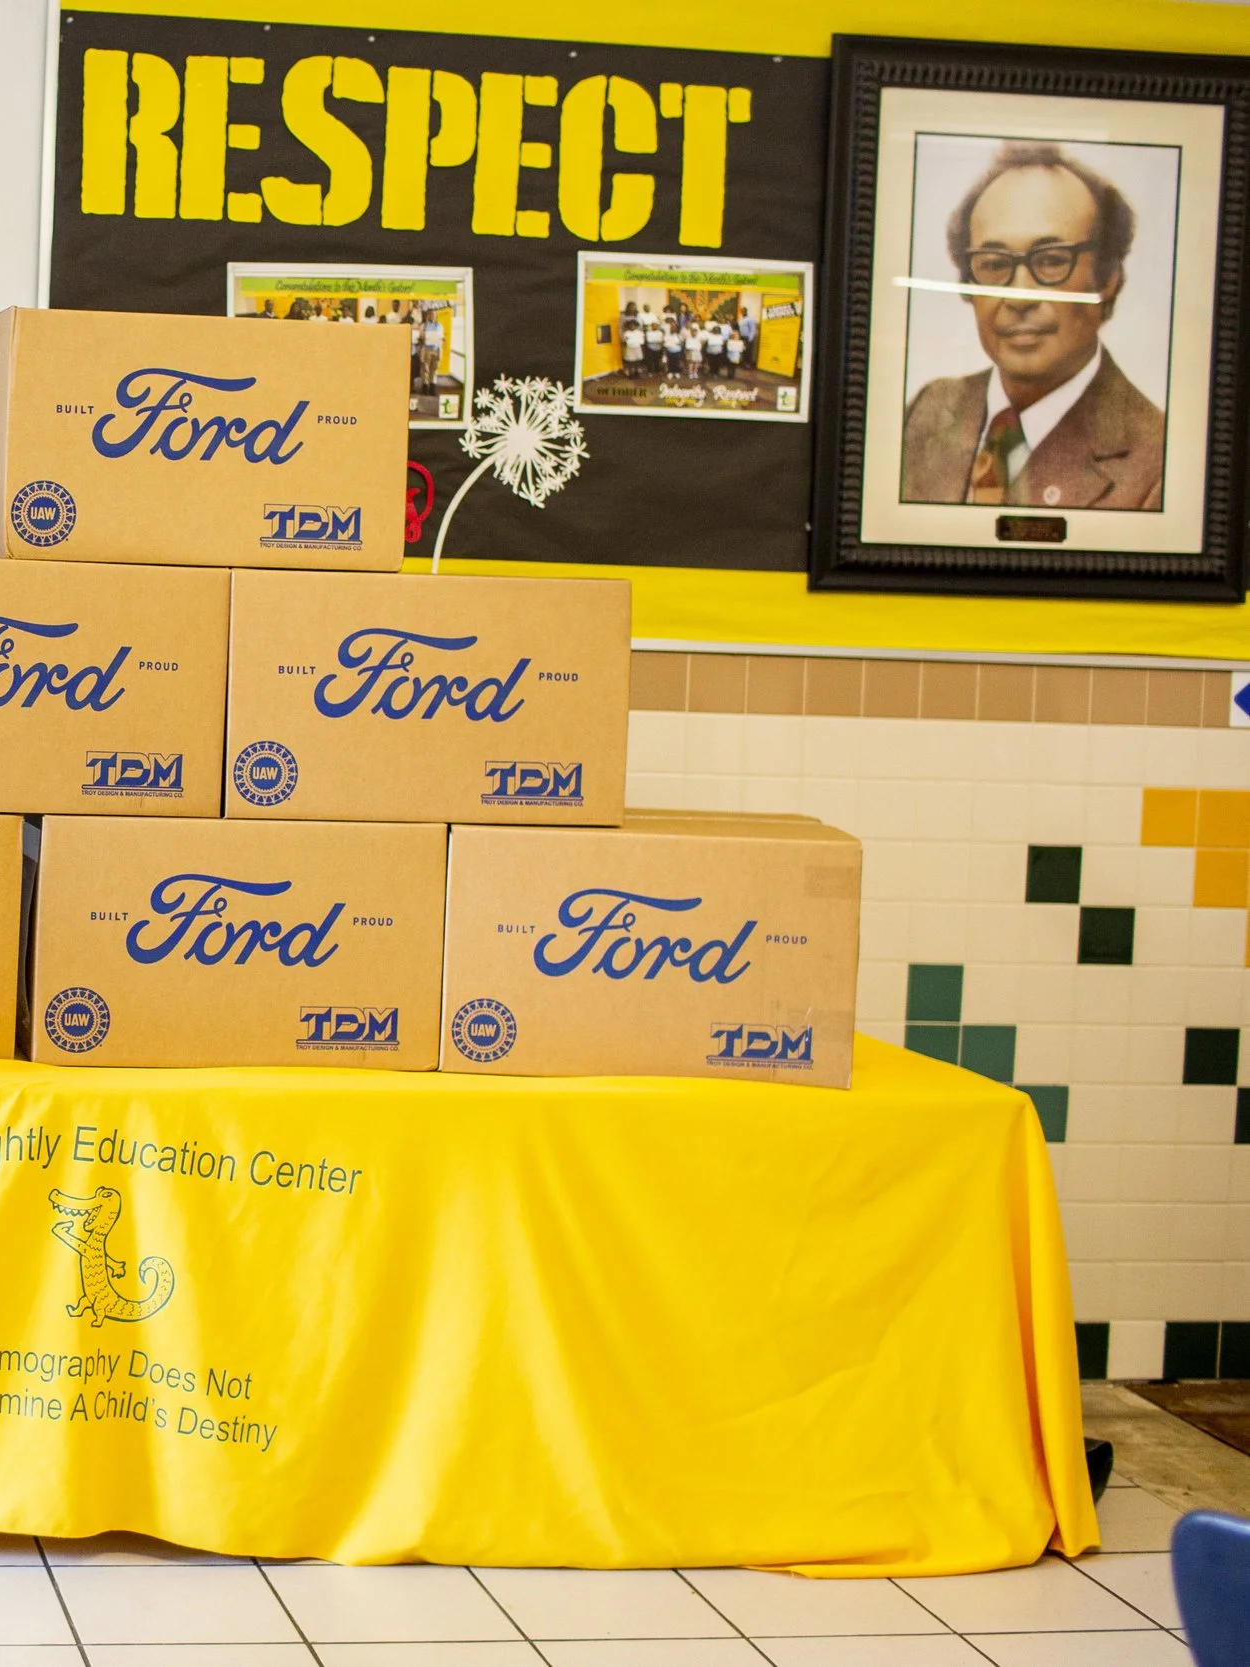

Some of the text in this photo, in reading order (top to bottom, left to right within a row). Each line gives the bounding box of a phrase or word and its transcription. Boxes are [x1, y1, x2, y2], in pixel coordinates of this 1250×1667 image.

[81, 48, 751, 248] RESPECT
[55, 368, 358, 465] BUILT Ford PROUD
[30, 506, 56, 520] UAW
[264, 504, 361, 540] TDM
[138, 660, 179, 672] PROUD
[278, 628, 579, 722] BUILT Ford PROUD
[86, 751, 183, 787] TDM
[252, 766, 278, 780] UAW
[485, 761, 582, 797] TDM
[90, 874, 394, 968] BUILT Ford PROUD
[497, 889, 808, 985] BUILT Ford PROUD
[64, 1013, 90, 1027] UAW
[300, 1006, 398, 1041] TDM
[471, 1024, 497, 1037] UAW
[711, 1023, 812, 1060] TDM
[73, 1126, 236, 1181] Education
[250, 1151, 363, 1194] Center
[128, 1350, 196, 1392] Does
[206, 1368, 253, 1400] Not
[69, 1392, 88, 1421] A
[93, 1391, 167, 1429] Child's
[177, 1407, 278, 1452] Destiny
